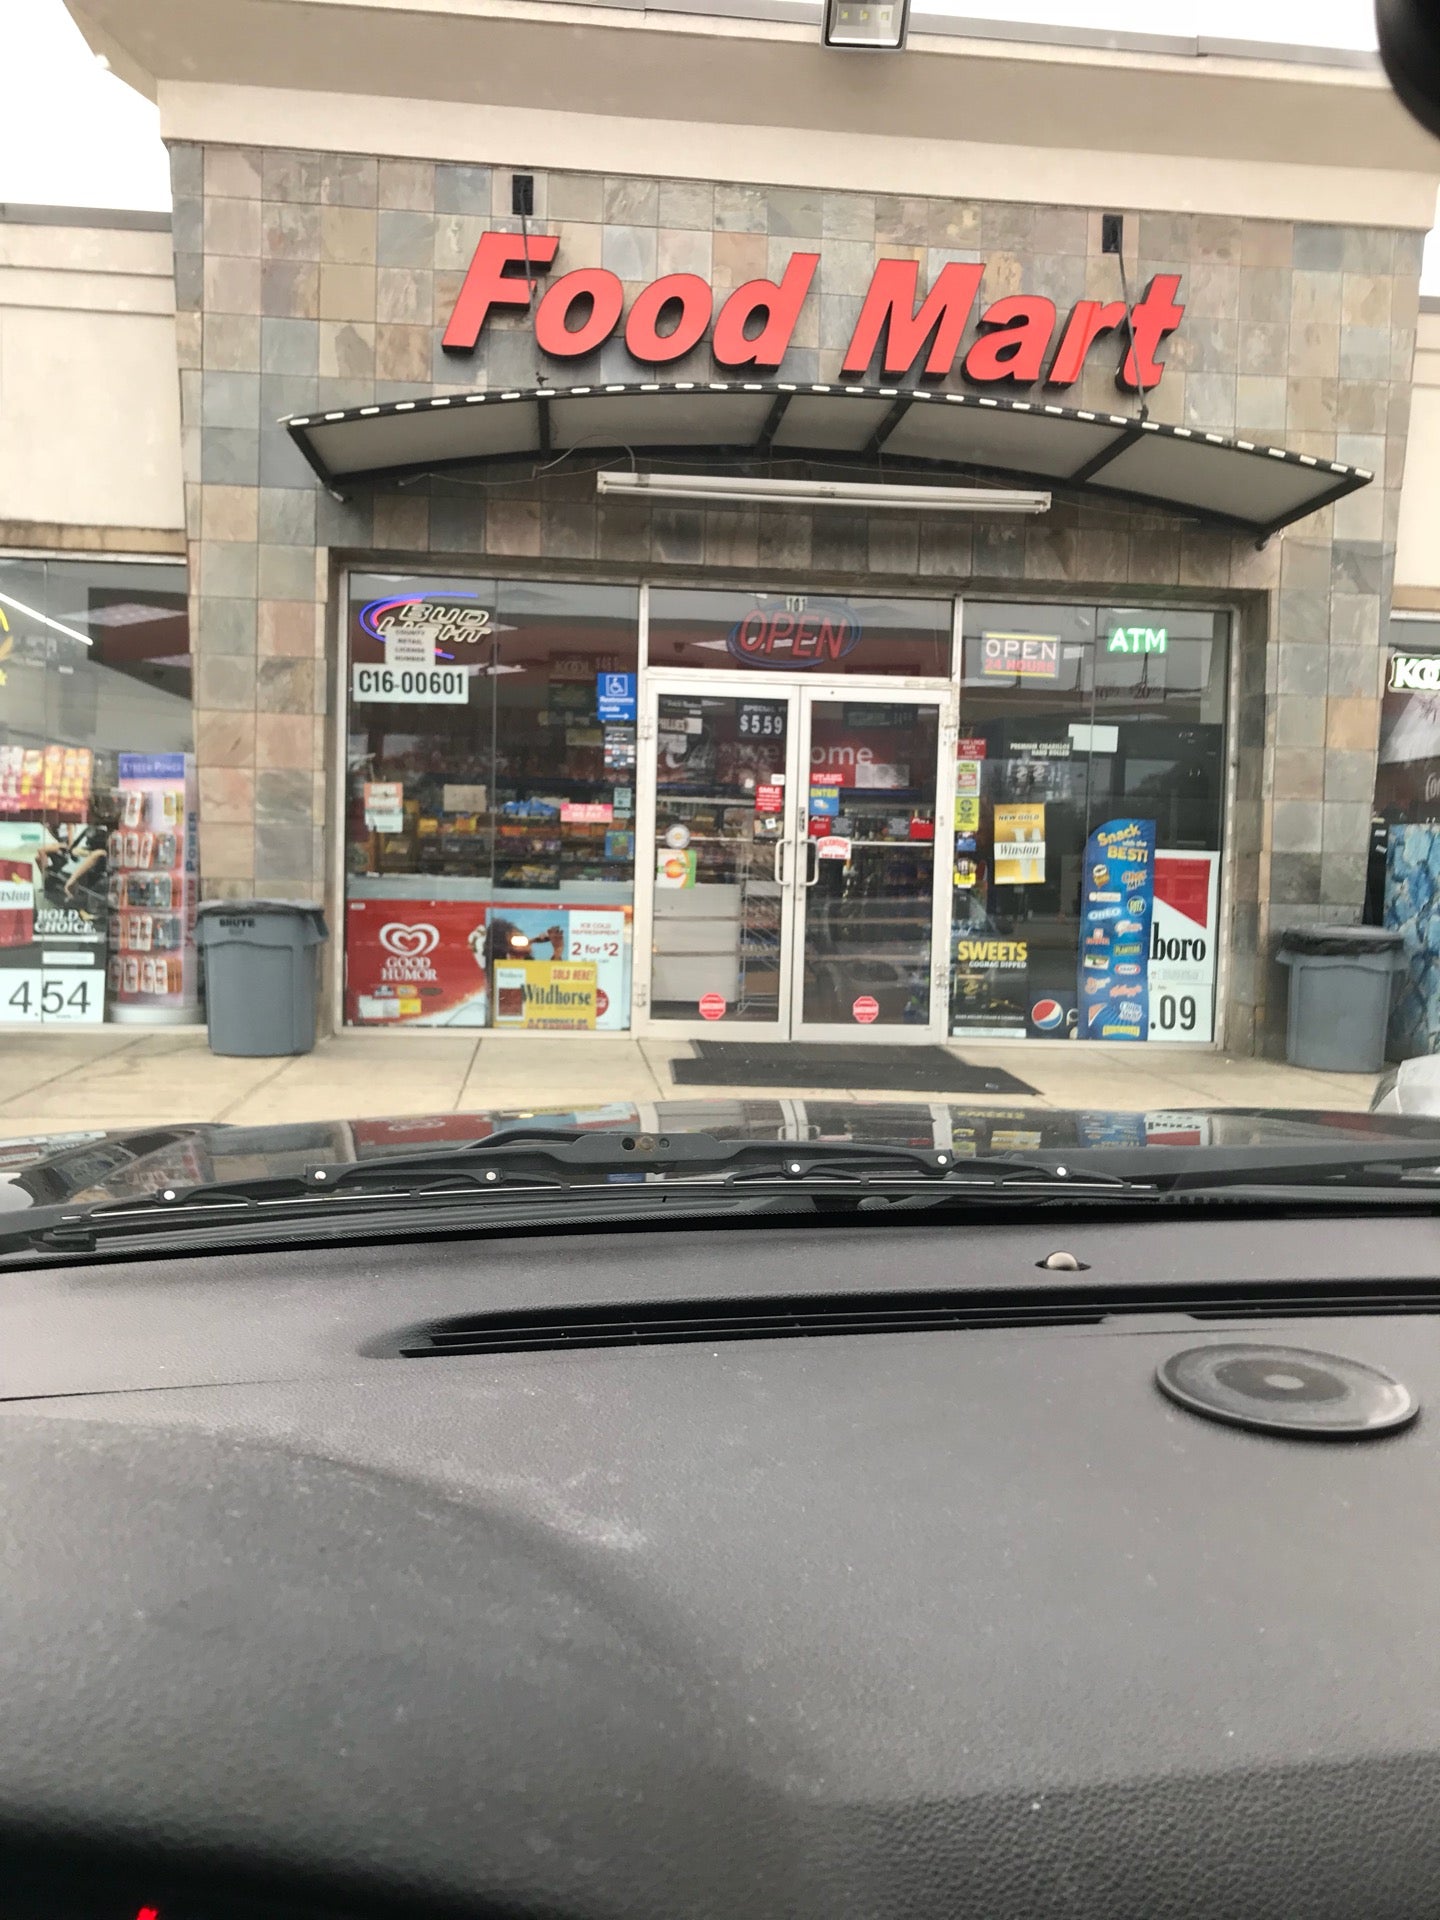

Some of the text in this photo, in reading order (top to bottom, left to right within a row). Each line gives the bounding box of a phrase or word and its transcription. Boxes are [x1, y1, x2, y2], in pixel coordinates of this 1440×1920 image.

[442, 231, 1186, 393] Food Mart
[399, 603, 489, 626] BUD
[739, 609, 848, 660] OPEN
[1109, 627, 1168, 653] ATM
[986, 639, 1056, 660] OPEN
[985, 658, 1056, 674] 24 HOURS
[359, 670, 463, 695] C16-00601
[740, 714, 783, 735] $5.59
[1097, 824, 1140, 847] Snack
[1000, 845, 1040, 856] Winston
[1107, 845, 1148, 863] BEST!
[1087, 906, 1122, 920] OREO
[219, 919, 256, 928] BRUTE
[571, 942, 582, 956] 2
[585, 944, 601, 954] for
[957, 941, 1028, 961] SWEETS
[386, 956, 432, 969] GOOD
[968, 961, 1027, 969] COGNAC DIPPED
[381, 967, 438, 982] HUMOR
[552, 969, 570, 980] SOLD
[520, 983, 592, 1005] Wildhorse
